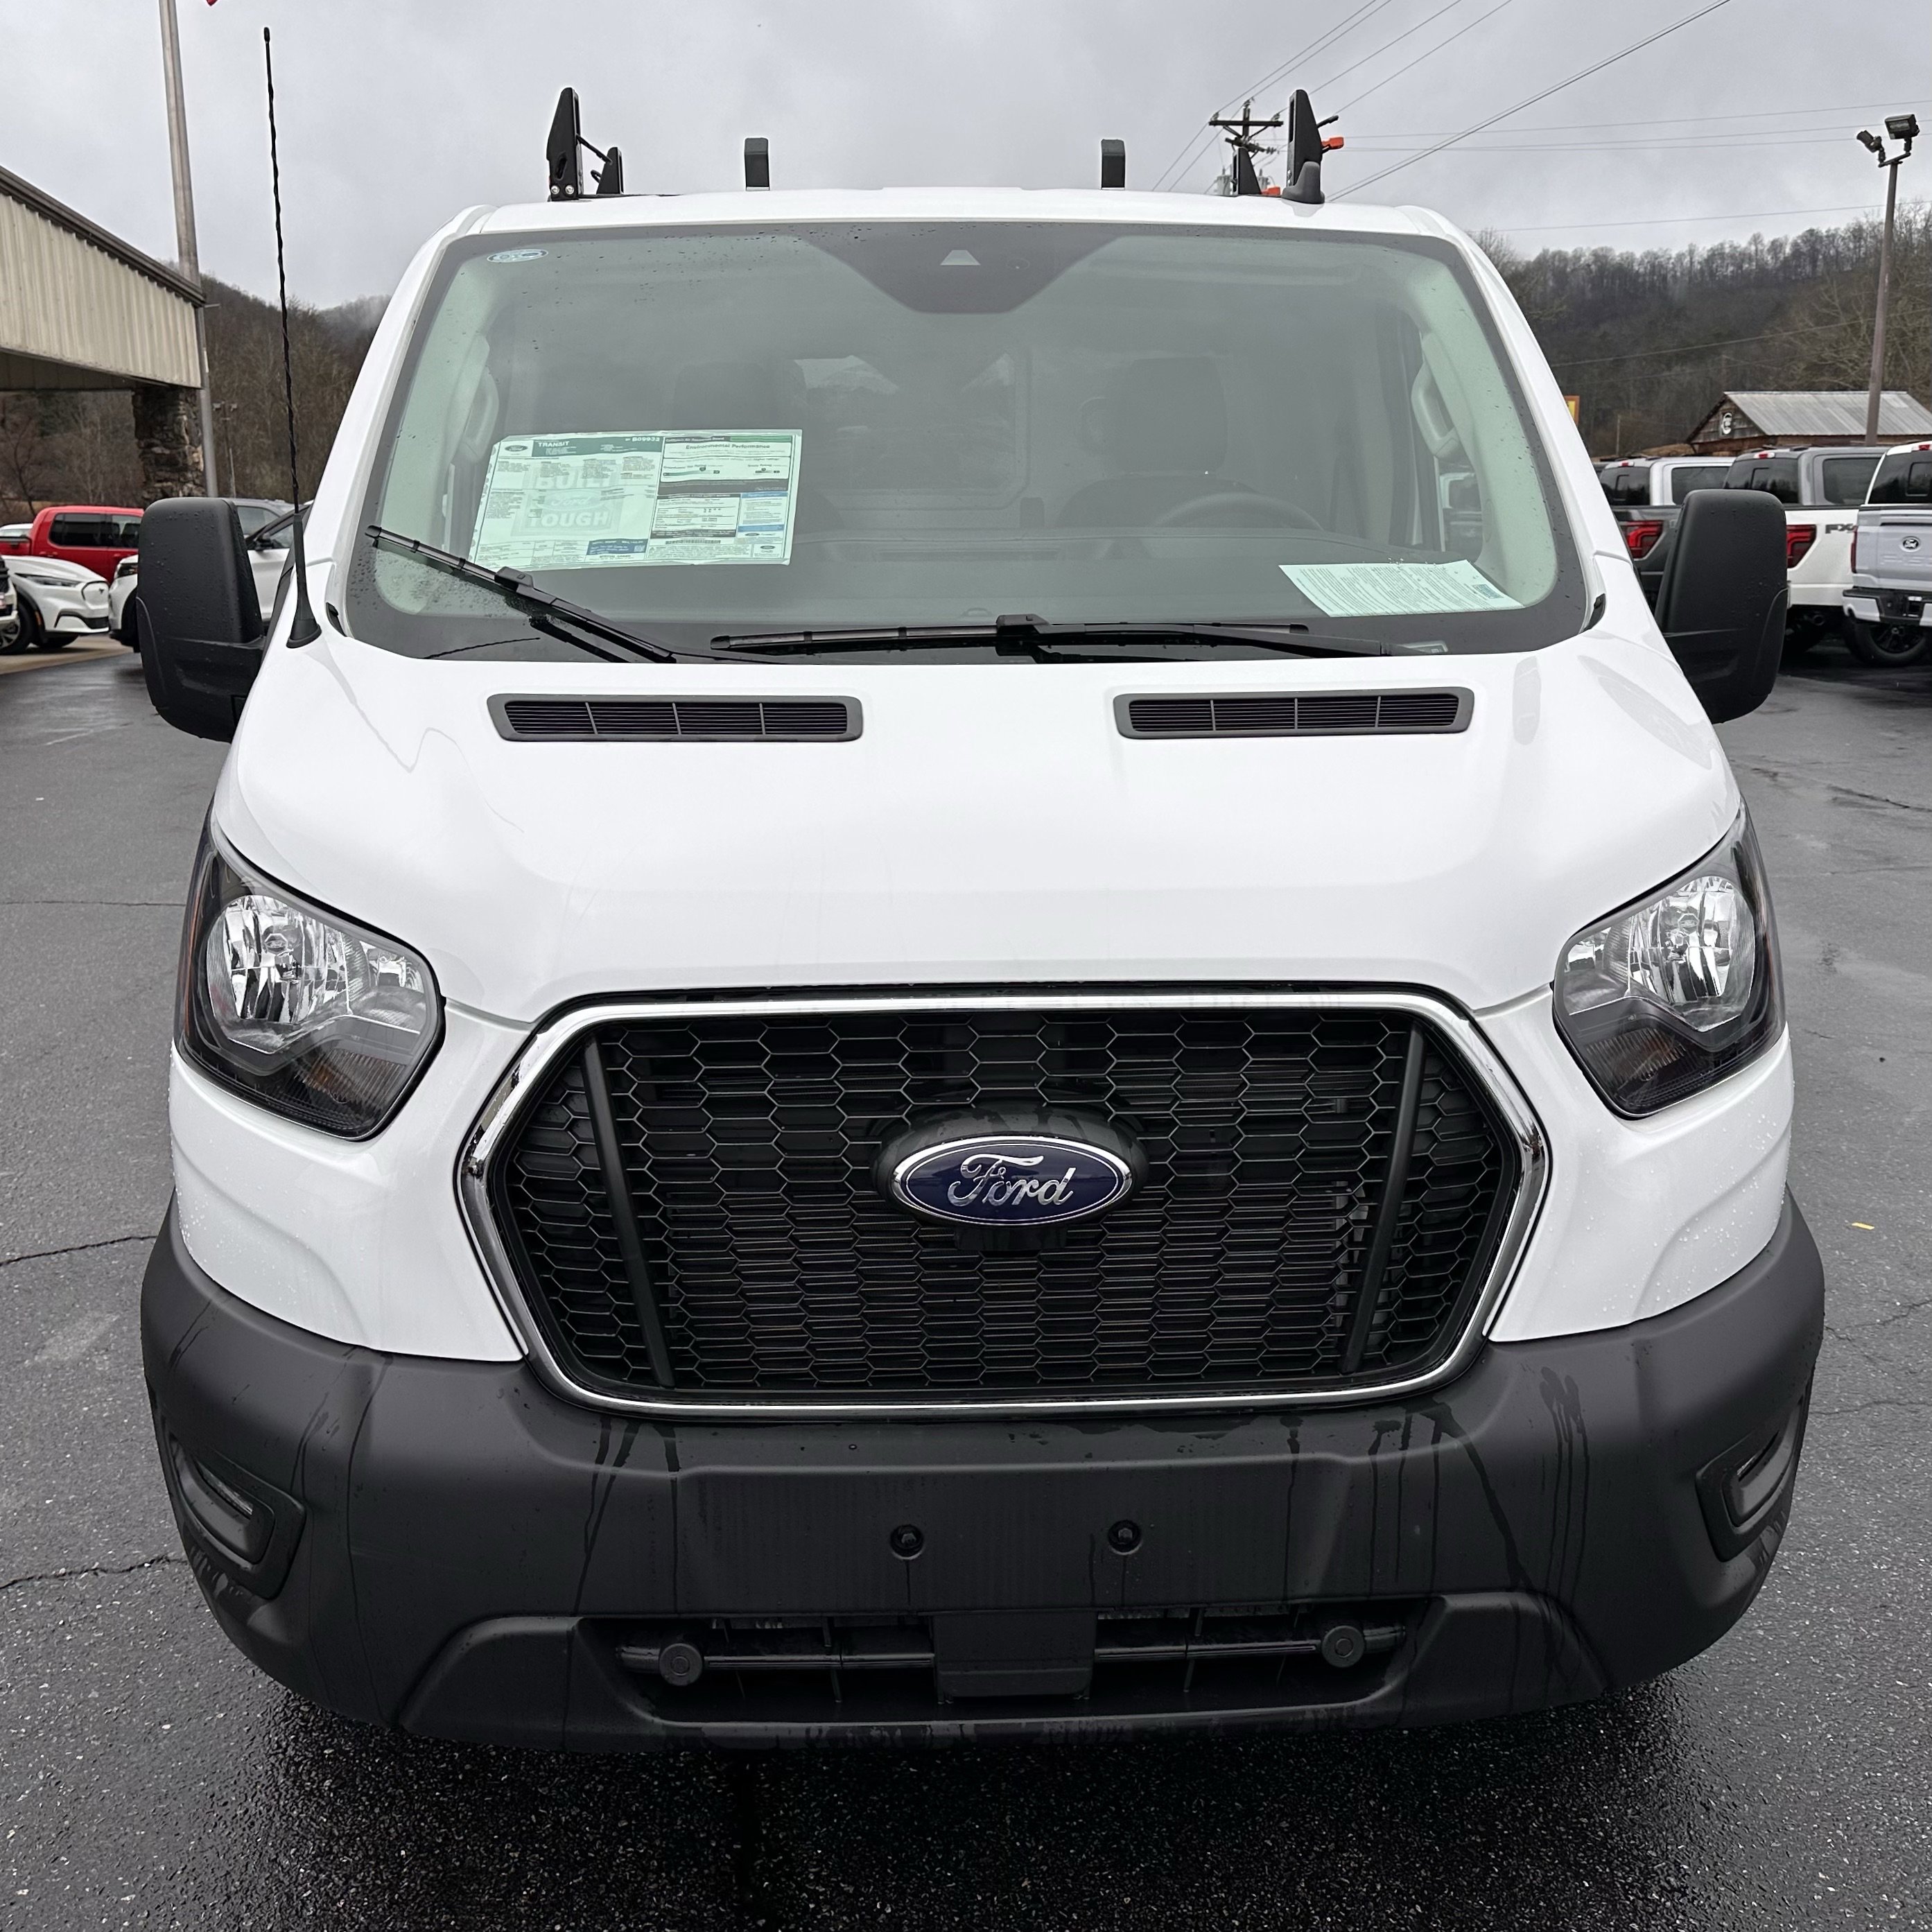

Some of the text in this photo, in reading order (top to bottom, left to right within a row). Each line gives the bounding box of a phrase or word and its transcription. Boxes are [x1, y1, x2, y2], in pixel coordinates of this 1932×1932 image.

[530, 512, 610, 527] TOUGH
[1825, 523, 1858, 534] FX
[947, 1153, 1077, 1207] Ford
